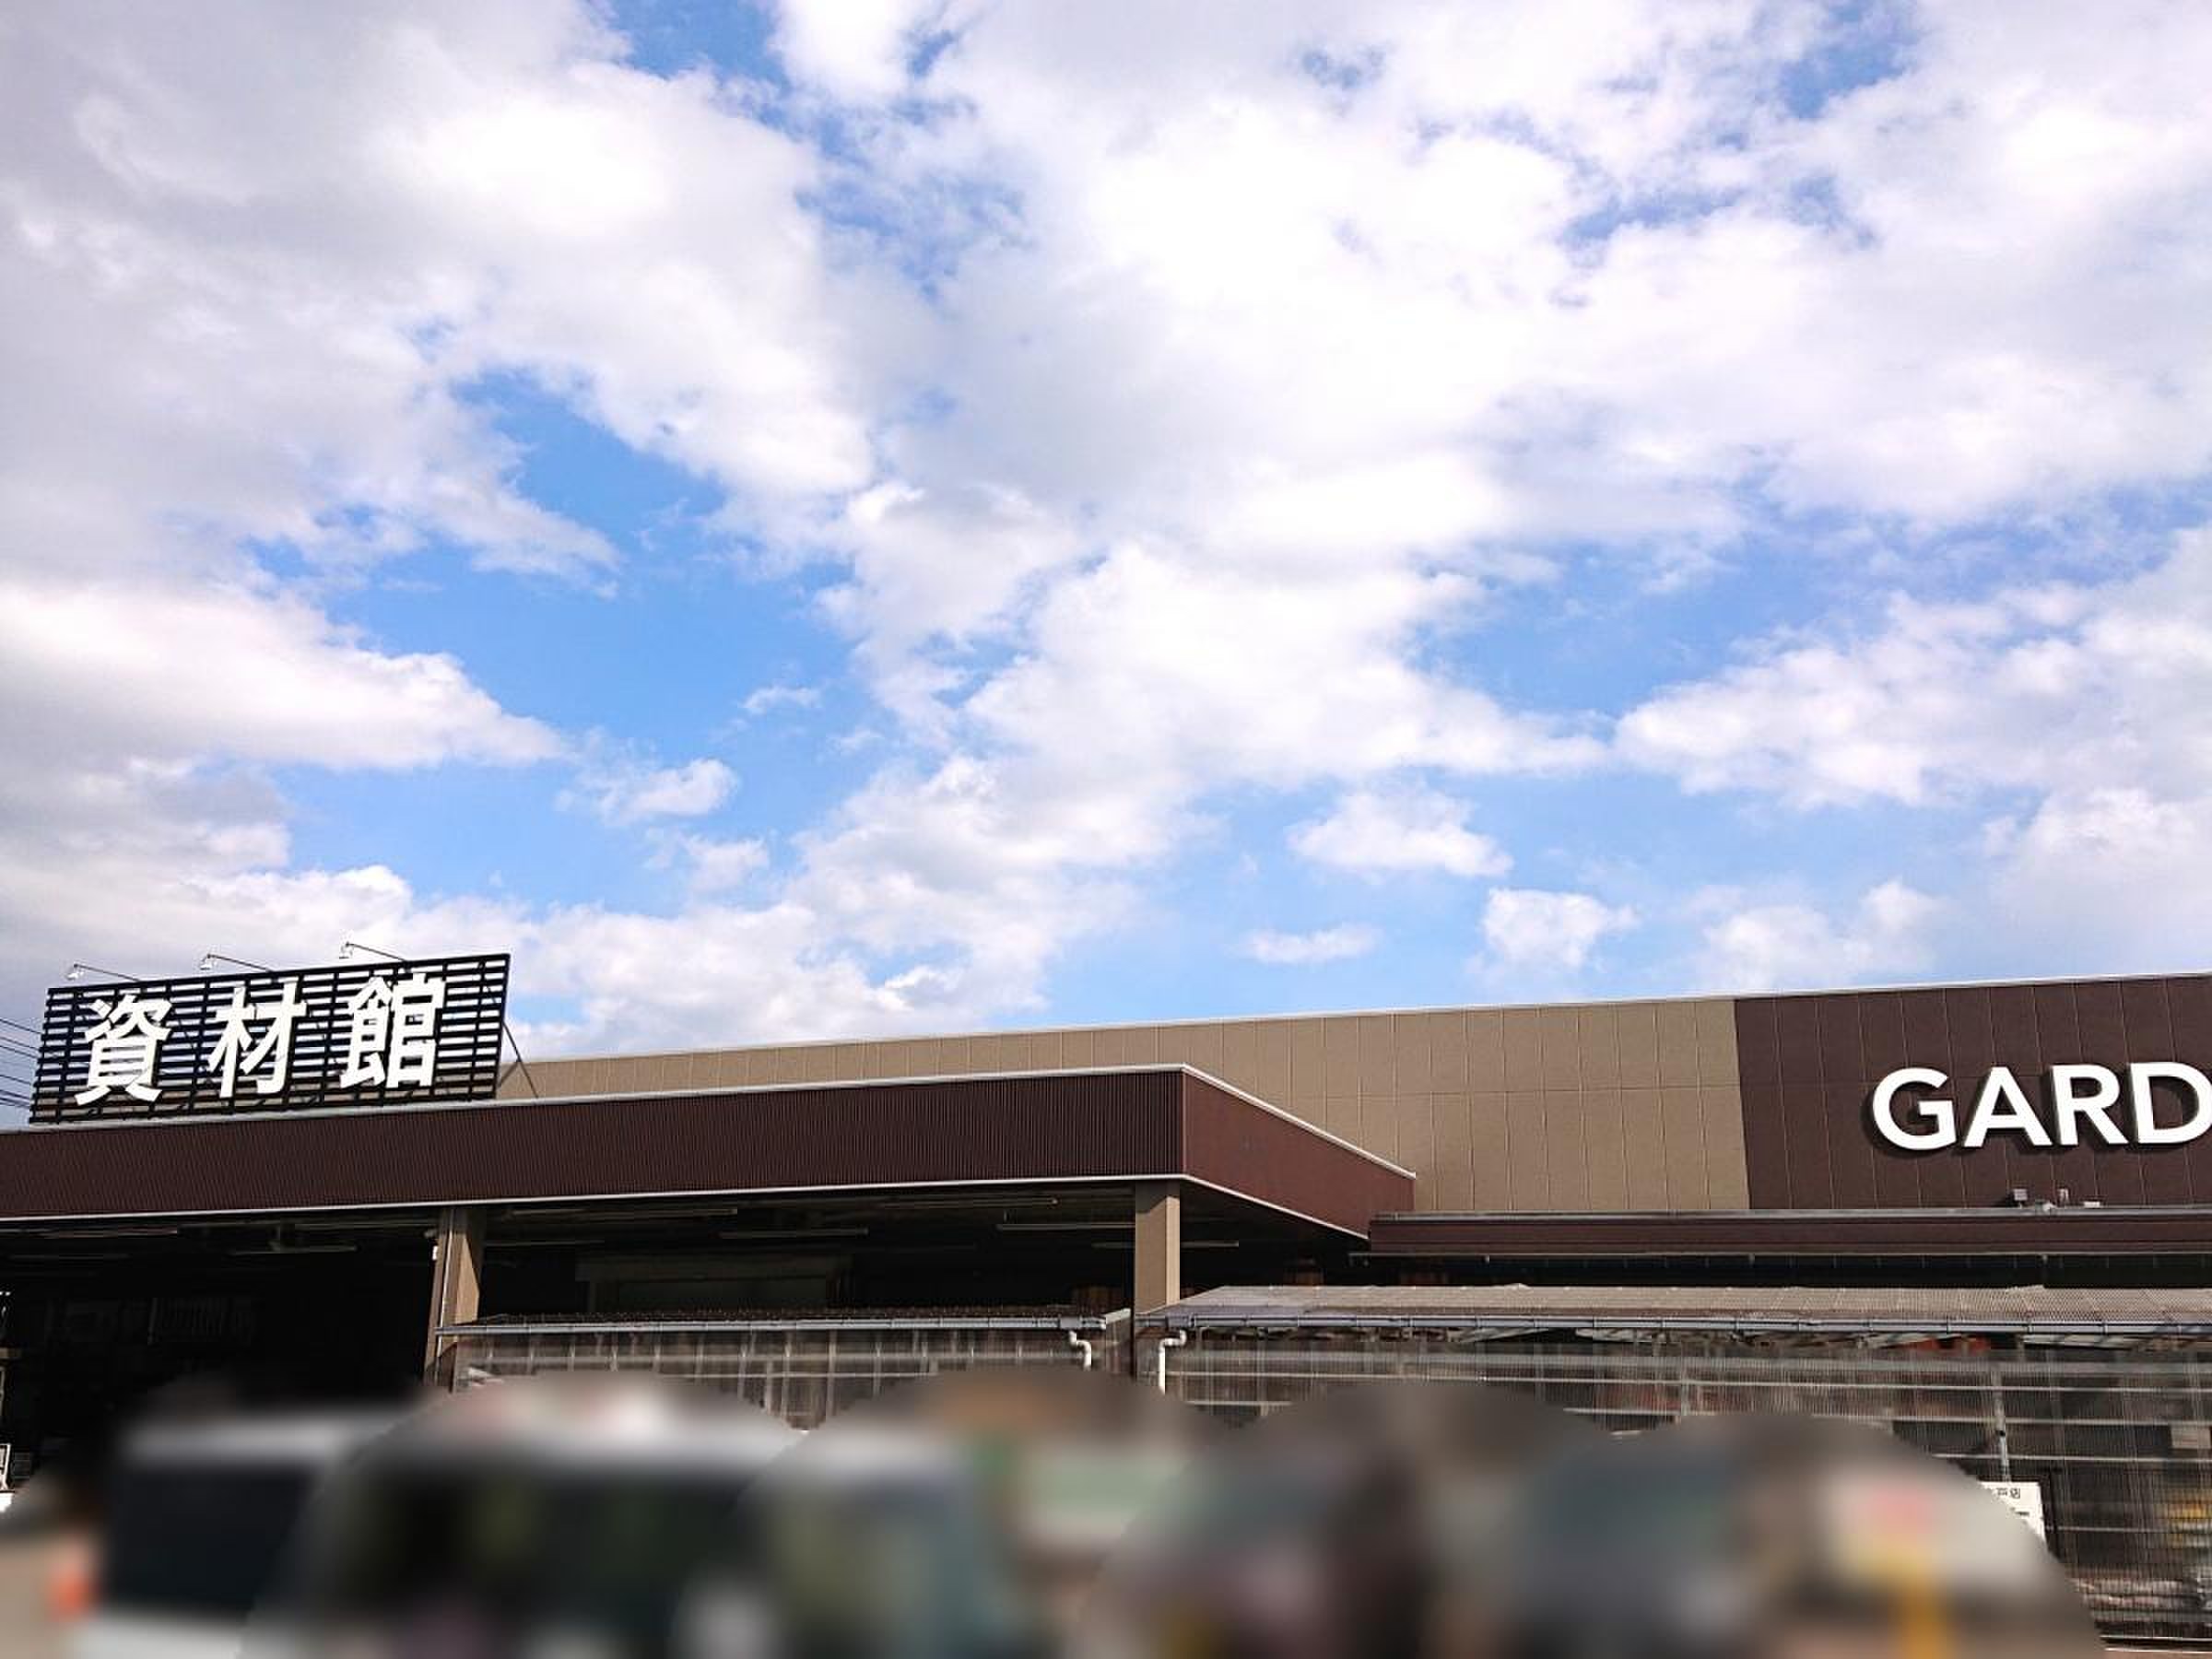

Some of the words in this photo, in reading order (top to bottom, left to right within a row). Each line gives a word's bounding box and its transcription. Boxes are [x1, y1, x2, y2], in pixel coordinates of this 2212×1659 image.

[76, 972, 445, 1105] 資材館
[1872, 1062, 2212, 1150] GARD
